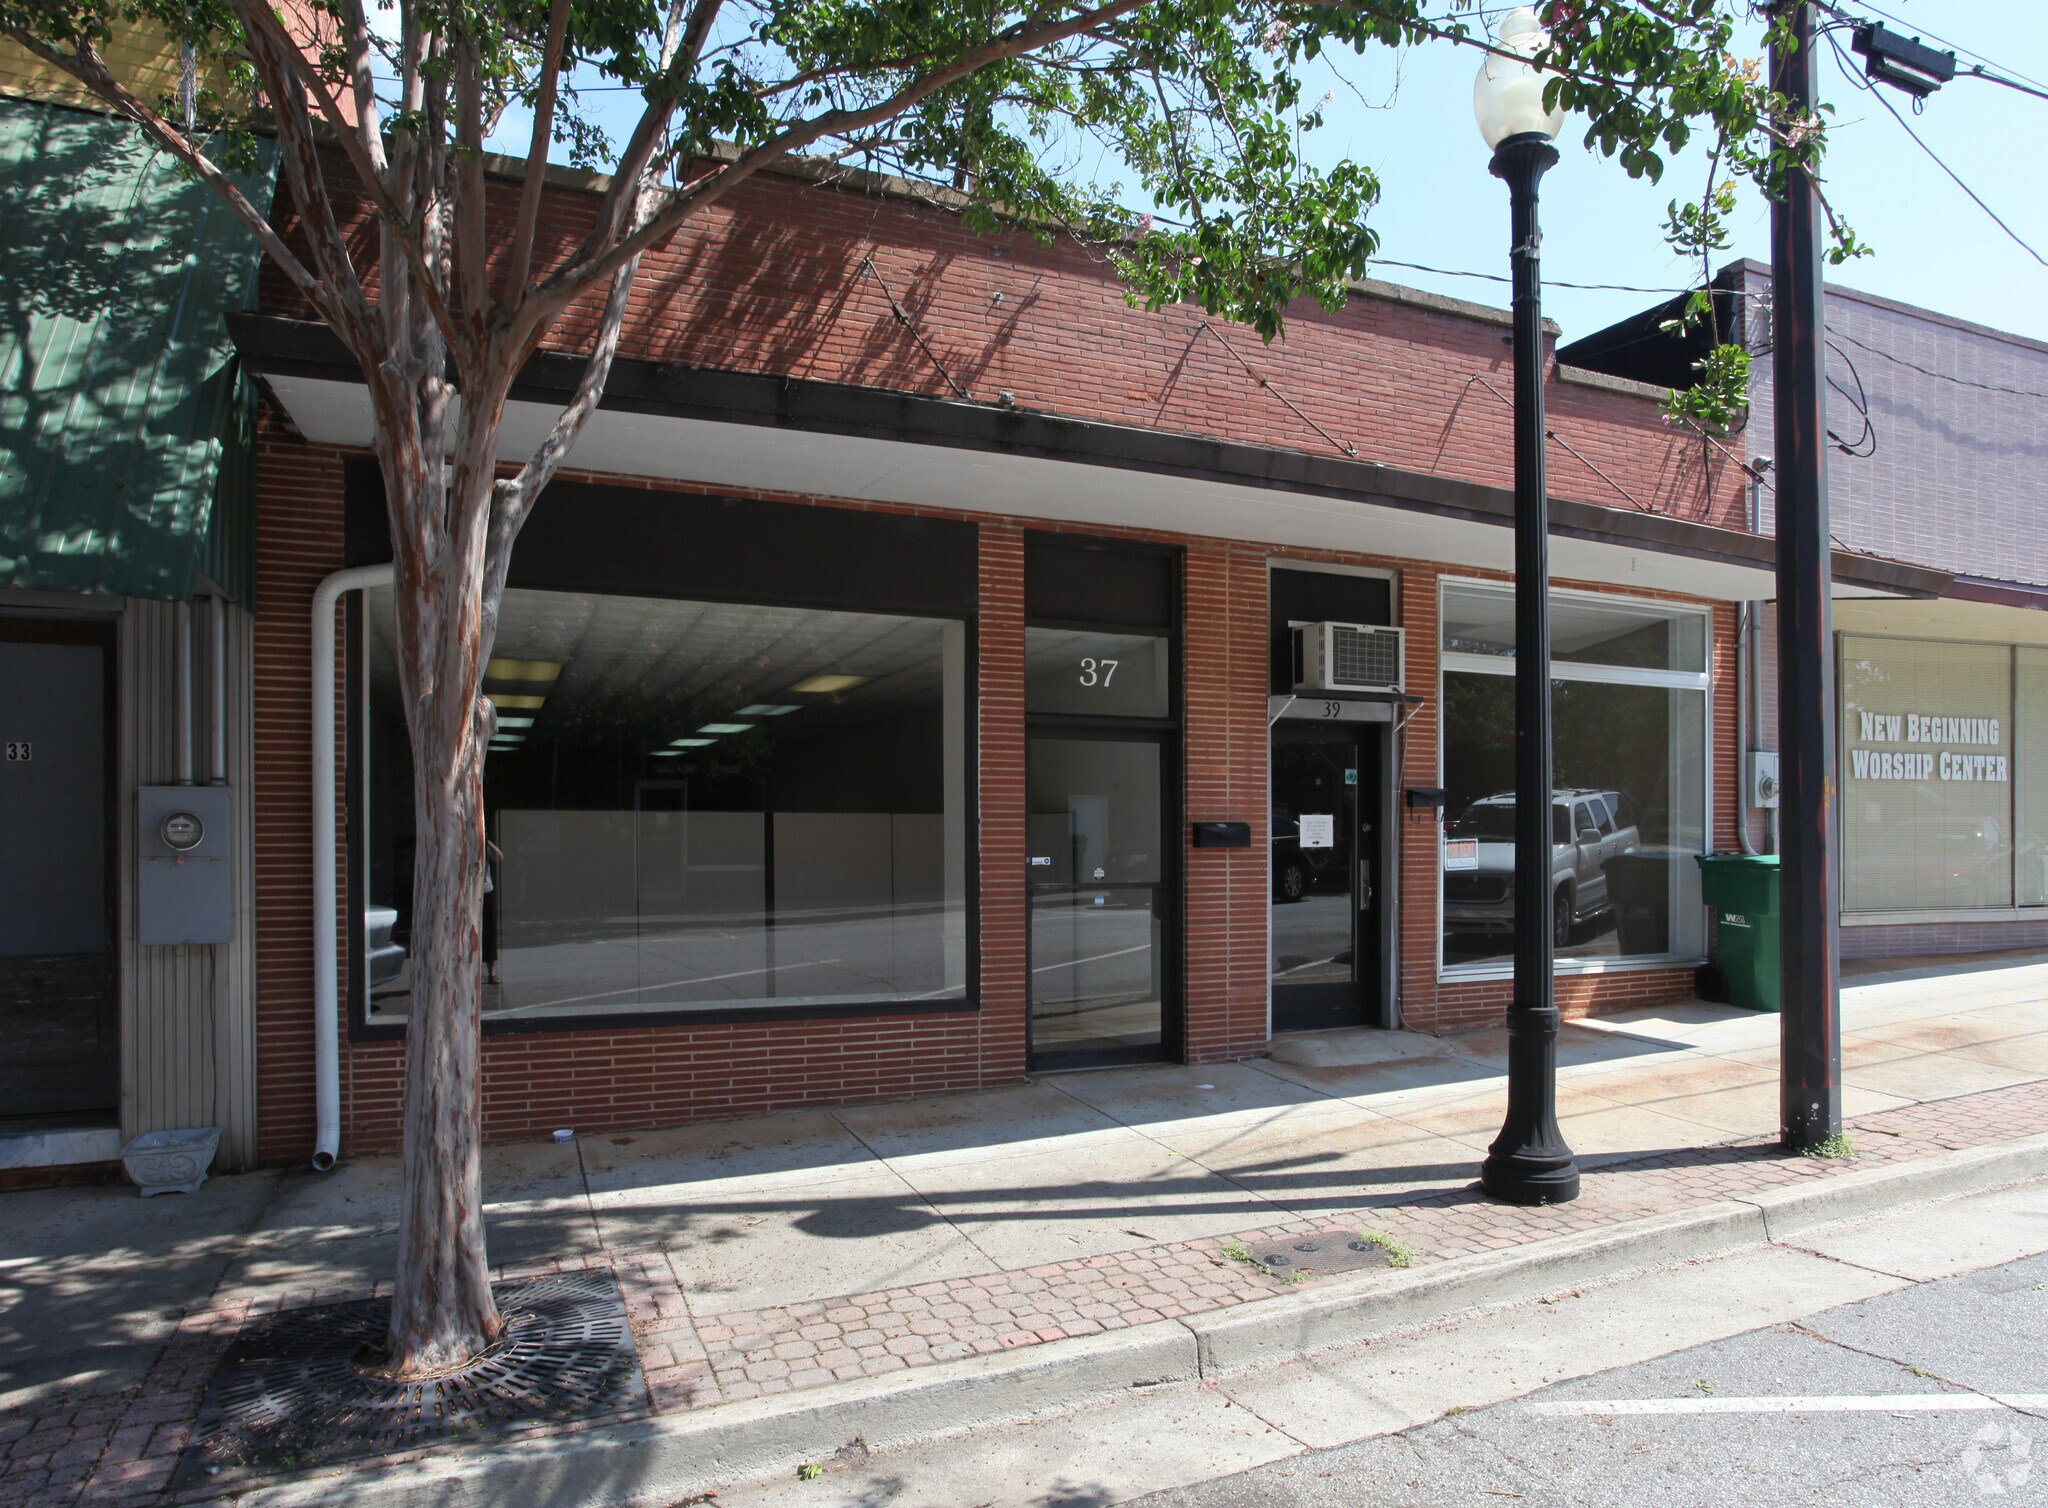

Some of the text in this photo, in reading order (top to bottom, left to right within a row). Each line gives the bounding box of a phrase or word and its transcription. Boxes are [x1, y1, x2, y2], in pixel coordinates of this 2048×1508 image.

[1080, 657, 1118, 687] 37
[1322, 701, 1340, 718] 39
[1860, 711, 1999, 745] NEW BEGINNING
[8, 743, 30, 760] 33
[1852, 750, 2007, 781] WORSHIP CENTER
